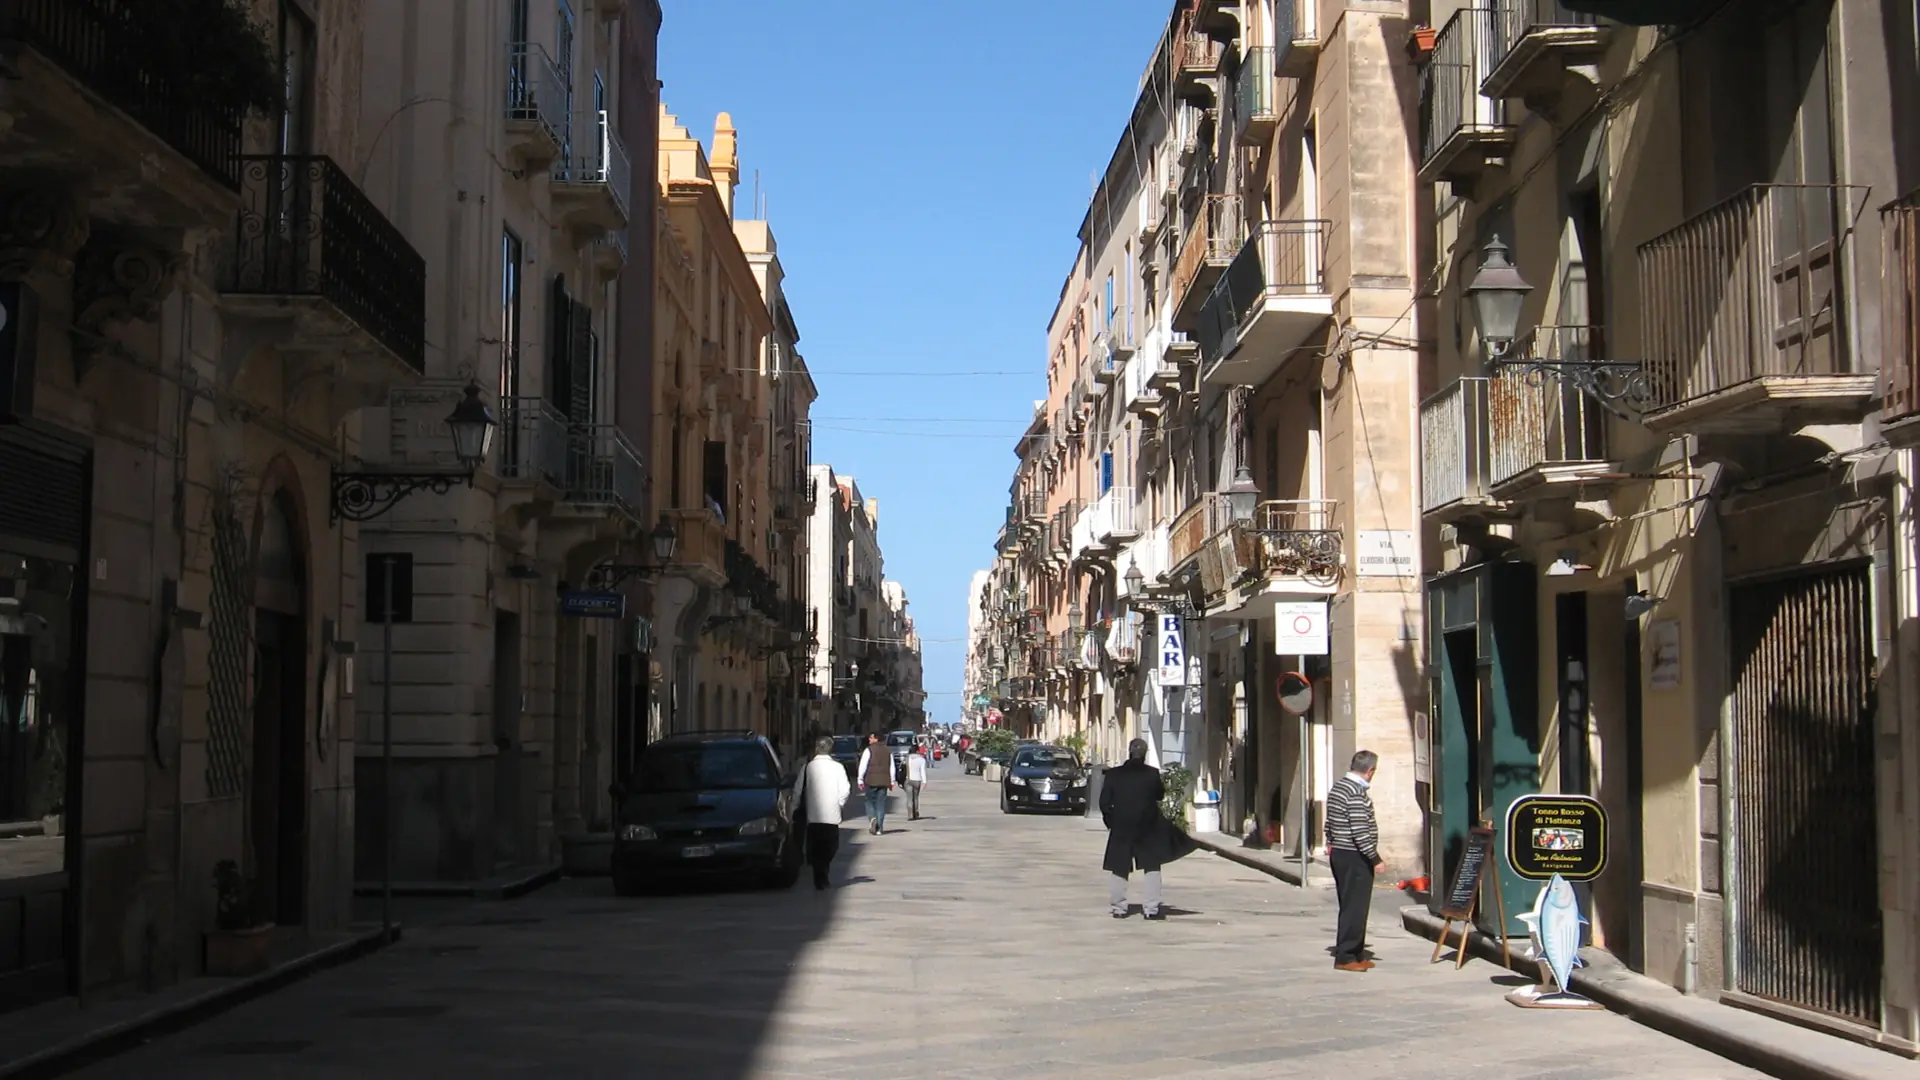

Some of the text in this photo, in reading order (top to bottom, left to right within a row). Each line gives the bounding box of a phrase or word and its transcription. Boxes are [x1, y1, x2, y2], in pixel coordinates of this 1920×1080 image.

[1162, 617, 1181, 666] BAR
[1532, 807, 1585, 816] Tonno Rosso
[1535, 817, 1582, 825] di Mattanza
[1533, 853, 1549, 861] Don
